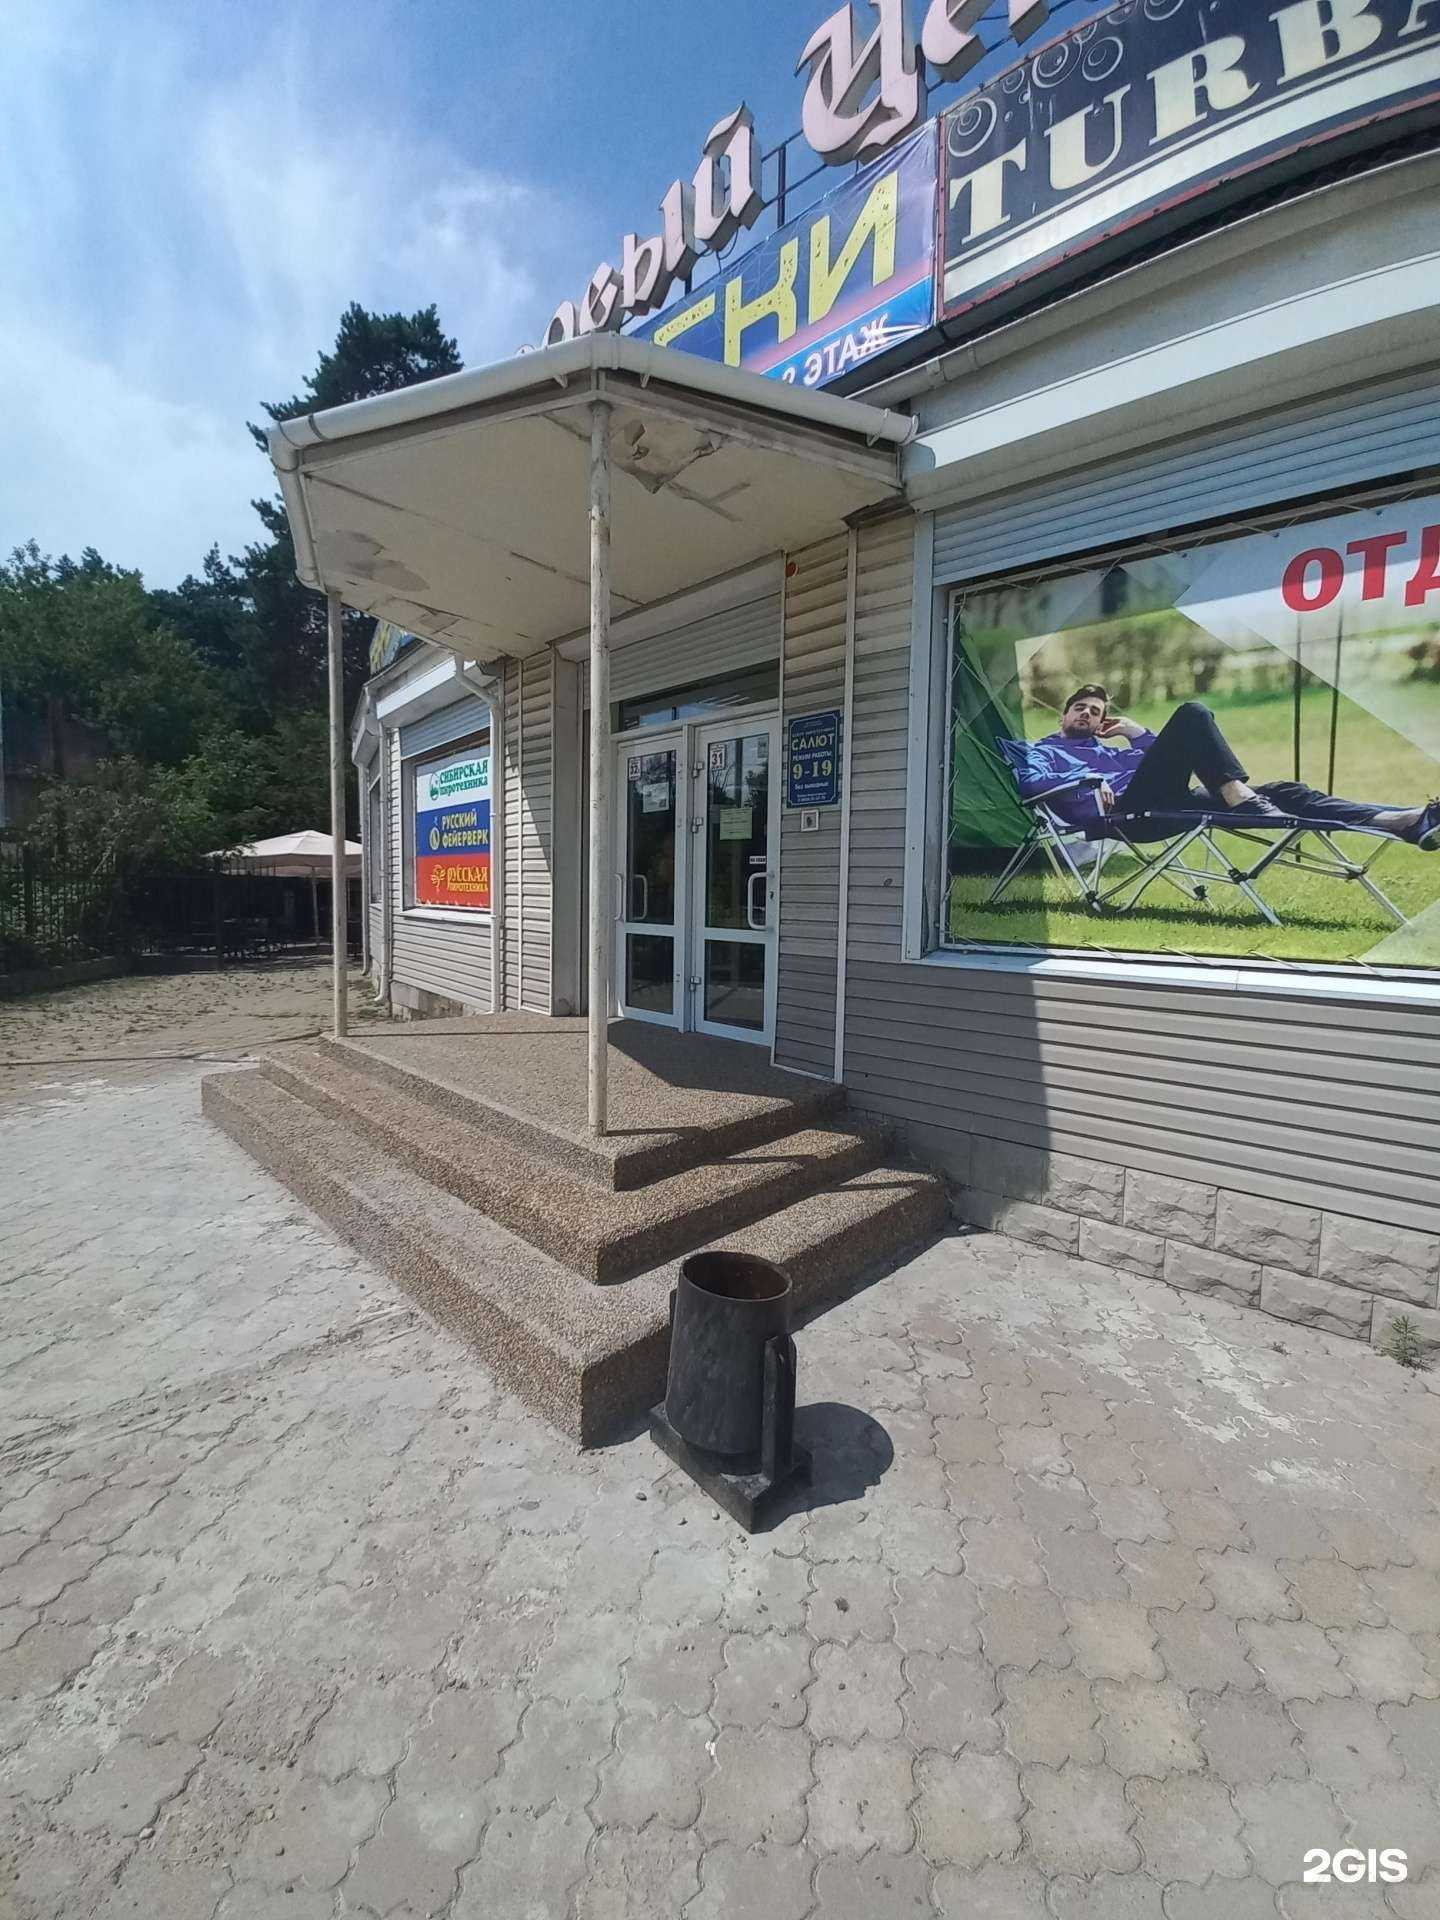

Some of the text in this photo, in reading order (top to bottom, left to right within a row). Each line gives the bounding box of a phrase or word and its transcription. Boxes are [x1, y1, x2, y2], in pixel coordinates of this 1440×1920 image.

[792, 733, 835, 751] САЛЮТ
[439, 759, 488, 784] СИБИРСКАЯ
[440, 776, 488, 797] пиротехника
[442, 808, 477, 830] РУССКИЙ
[442, 828, 489, 848] ФЕЙЕРВЕРК
[447, 865, 488, 885] РУССКАЯ
